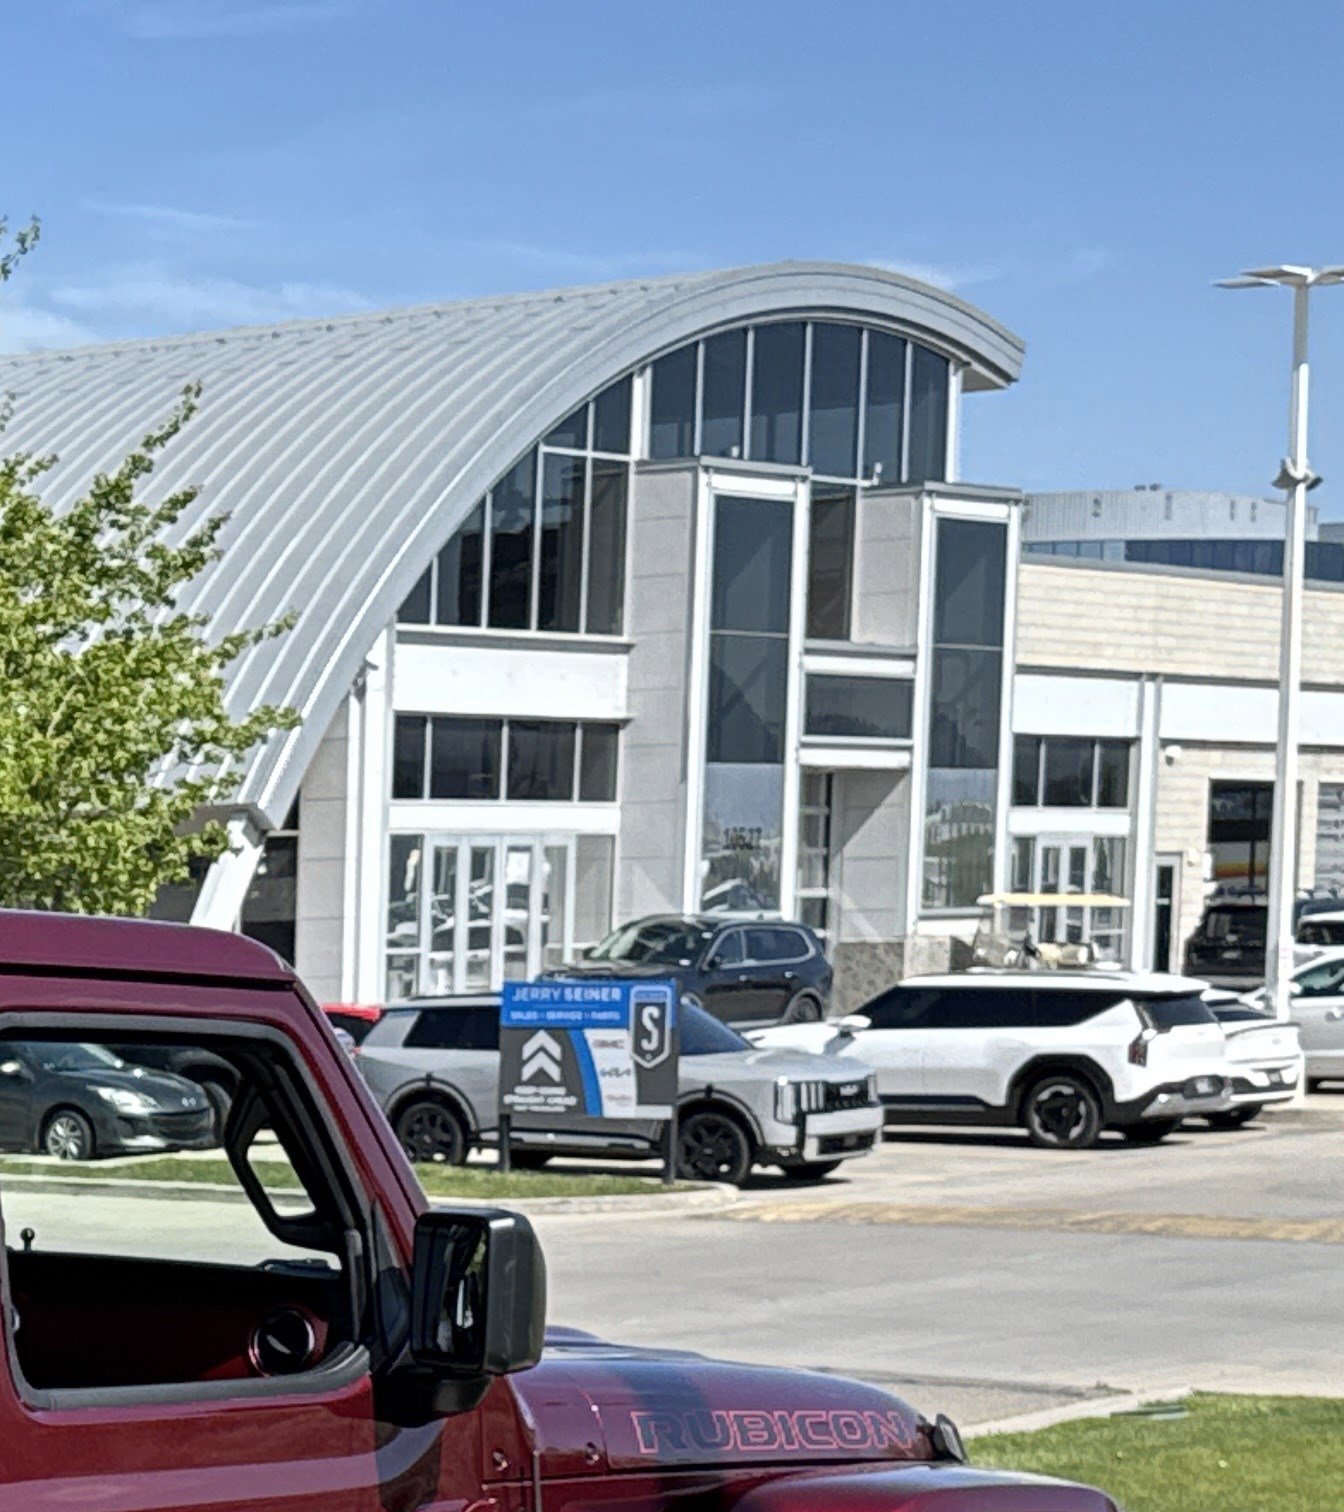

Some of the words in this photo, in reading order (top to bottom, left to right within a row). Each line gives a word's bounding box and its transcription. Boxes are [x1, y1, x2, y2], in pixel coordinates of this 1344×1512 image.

[513, 987, 561, 1001] JERRY
[563, 987, 622, 1001] SEINER
[640, 1005, 660, 1052] S
[629, 1409, 914, 1456] RUBICON
